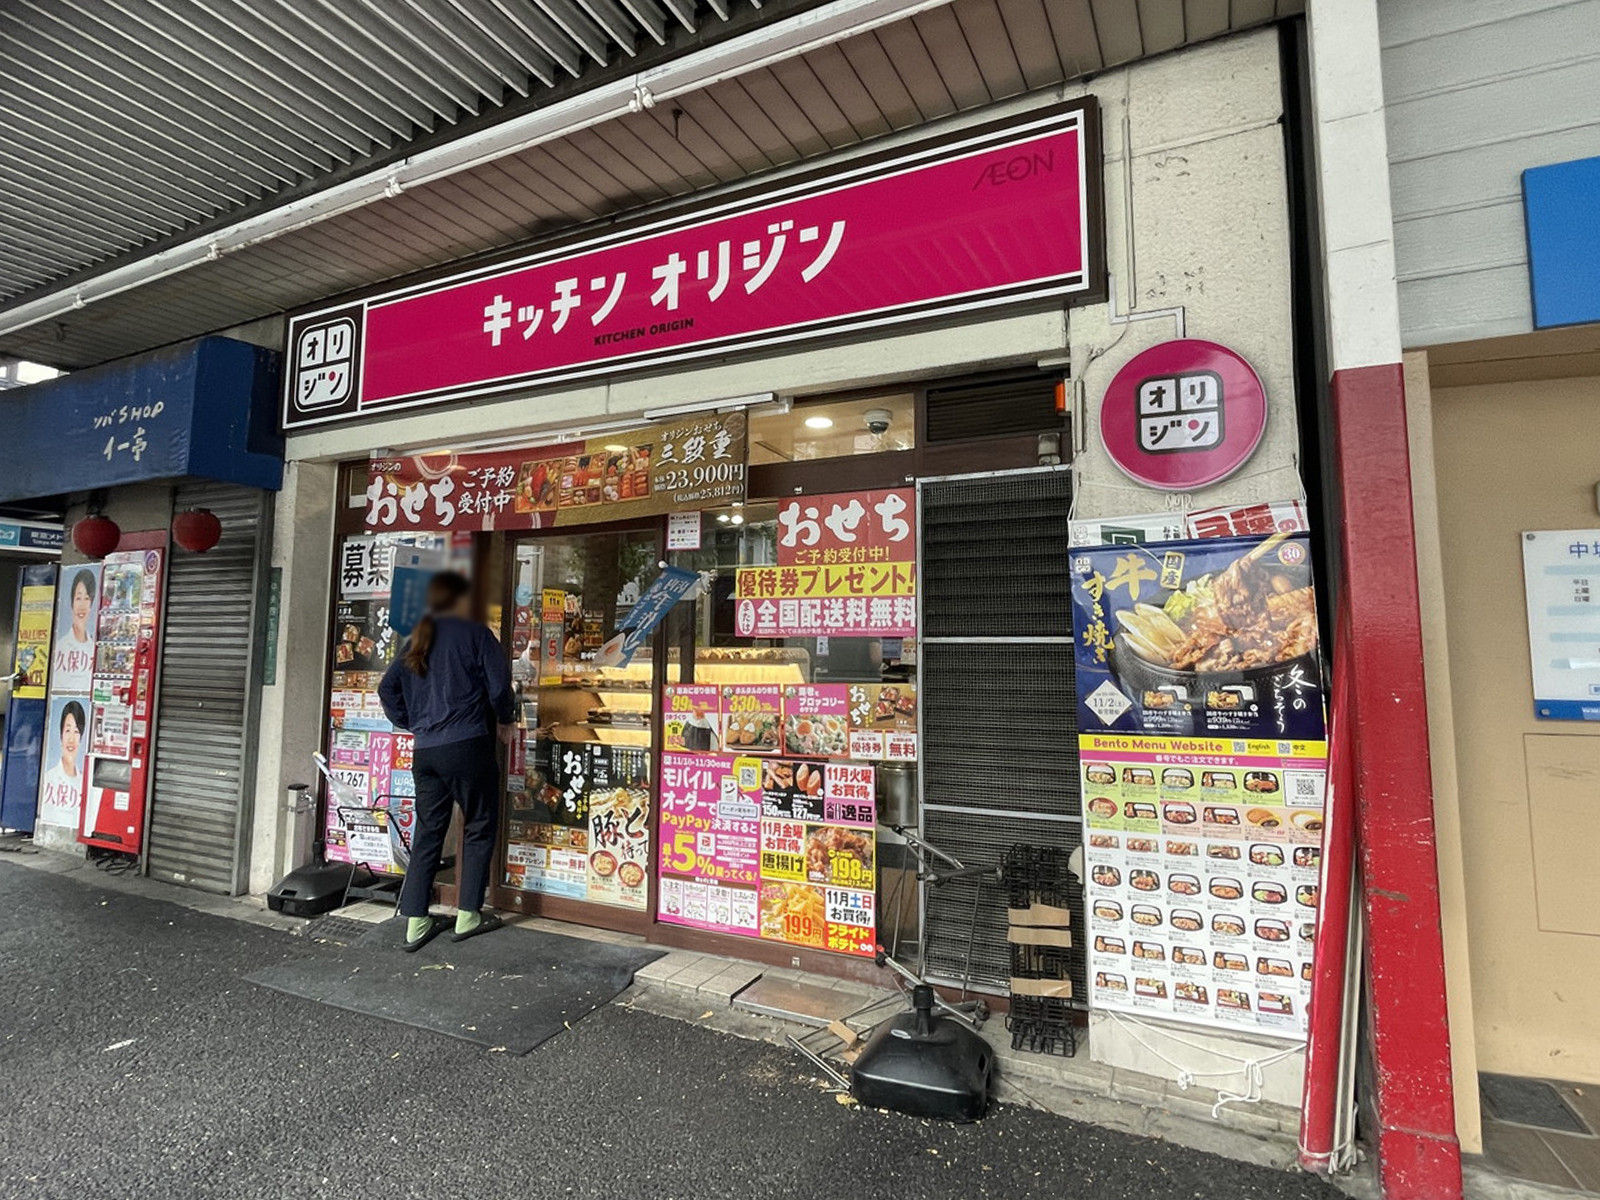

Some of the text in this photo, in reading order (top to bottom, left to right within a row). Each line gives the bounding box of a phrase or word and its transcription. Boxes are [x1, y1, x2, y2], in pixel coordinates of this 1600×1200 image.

[483, 219, 847, 347] キッチン オリジン
[594, 318, 694, 347] KITCHEN ORIGIN
[660, 420, 723, 442] オリジンおせち
[655, 429, 733, 467] 三段重
[370, 462, 402, 472] オリジンの
[462, 466, 516, 489] ご予約
[666, 462, 745, 491] 23,900円
[365, 475, 456, 527] おせち
[458, 490, 511, 515] 受付中
[778, 493, 910, 548] おせち
[794, 546, 891, 565] ご予約受付中!
[737, 566, 916, 597] 優待券プレゼント!
[1105, 553, 1158, 600] 牛
[742, 604, 751, 636] または
[757, 598, 916, 628] 全国配送料無料
[1282, 664, 1318, 710] 冬の
[799, 698, 846, 707] ブロッコリー
[850, 685, 871, 725] おせち
[373, 737, 381, 776] パート
[1093, 738, 1223, 753] Bento Menu Website
[1247, 743, 1271, 753] English
[563, 750, 585, 812] おせち
[663, 767, 716, 790] モバイル
[826, 766, 873, 784] 11月火曜
[662, 790, 717, 815] オーダーで
[831, 784, 871, 800] お買得
[662, 811, 758, 835] PayPay 決済すると
[842, 803, 873, 823] 逸品
[762, 822, 804, 839] 11月金曜
[765, 838, 801, 853] お買得
[762, 852, 805, 872] 唐揚げ
[827, 890, 872, 910] 11月土日
[830, 907, 871, 926] お買得!
[827, 923, 870, 940] フライド
[827, 936, 860, 952] ポテト
